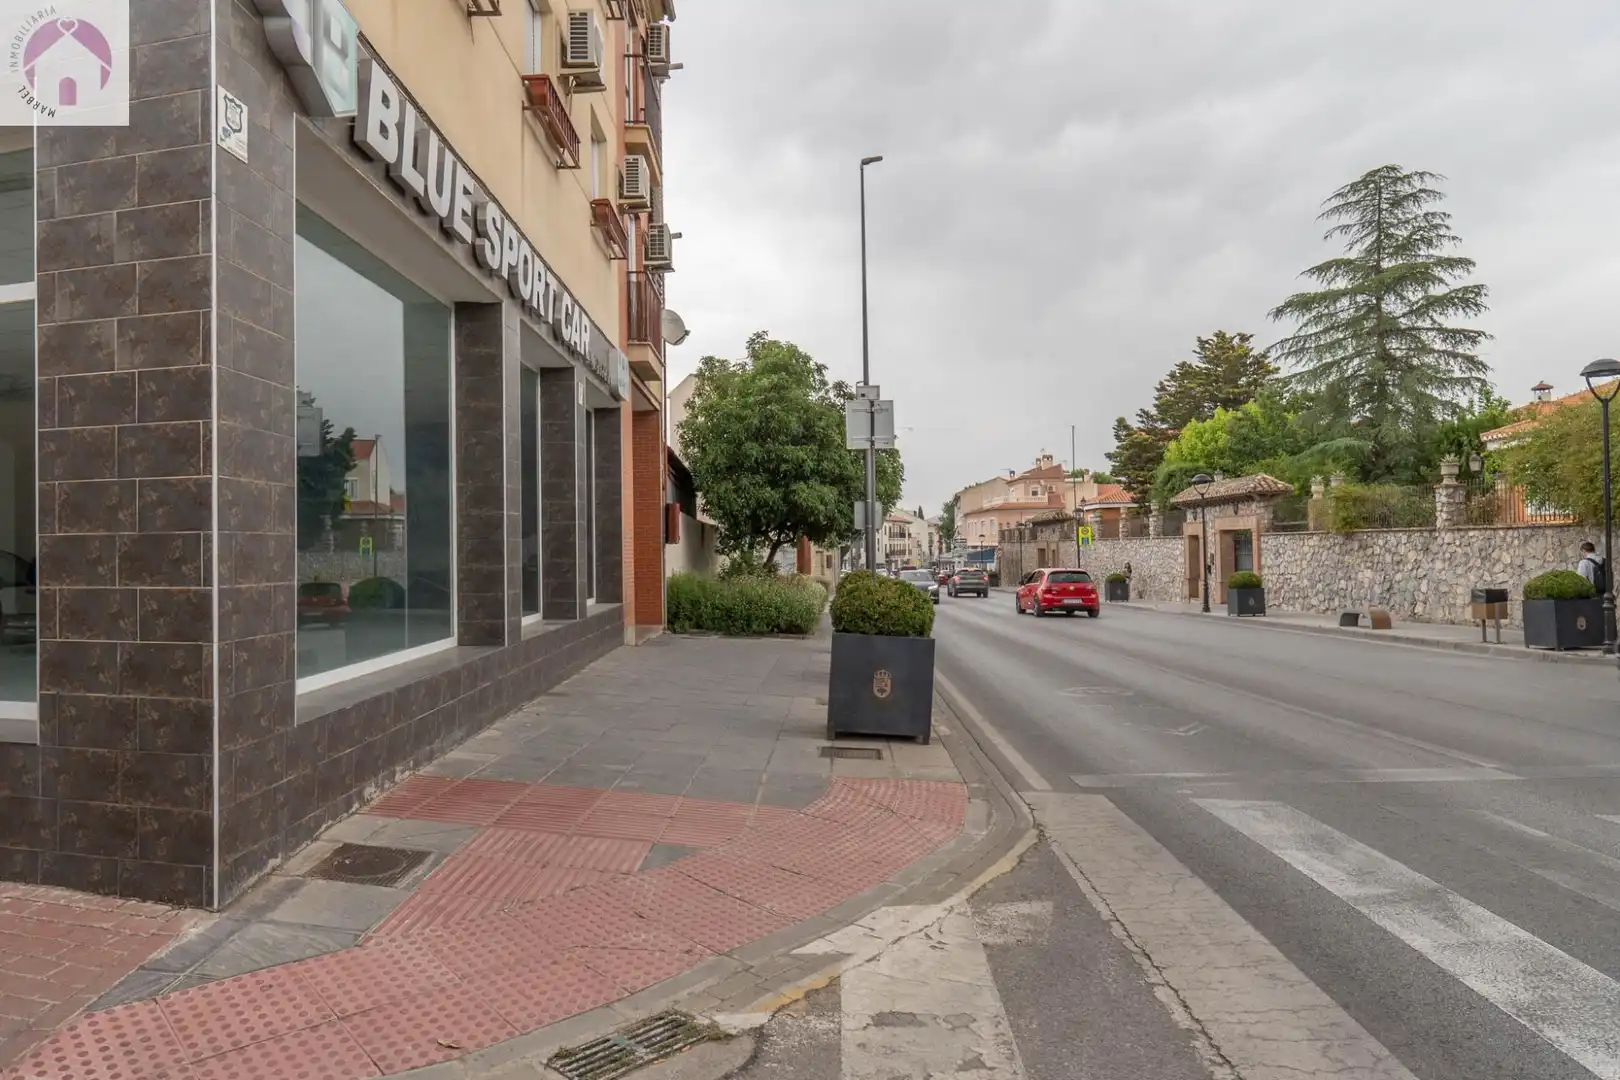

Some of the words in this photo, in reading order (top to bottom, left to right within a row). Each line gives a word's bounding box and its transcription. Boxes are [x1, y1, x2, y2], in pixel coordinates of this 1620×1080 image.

[364, 59, 475, 245] BLUE
[482, 201, 557, 325] SPORT
[560, 291, 591, 360] CAR
